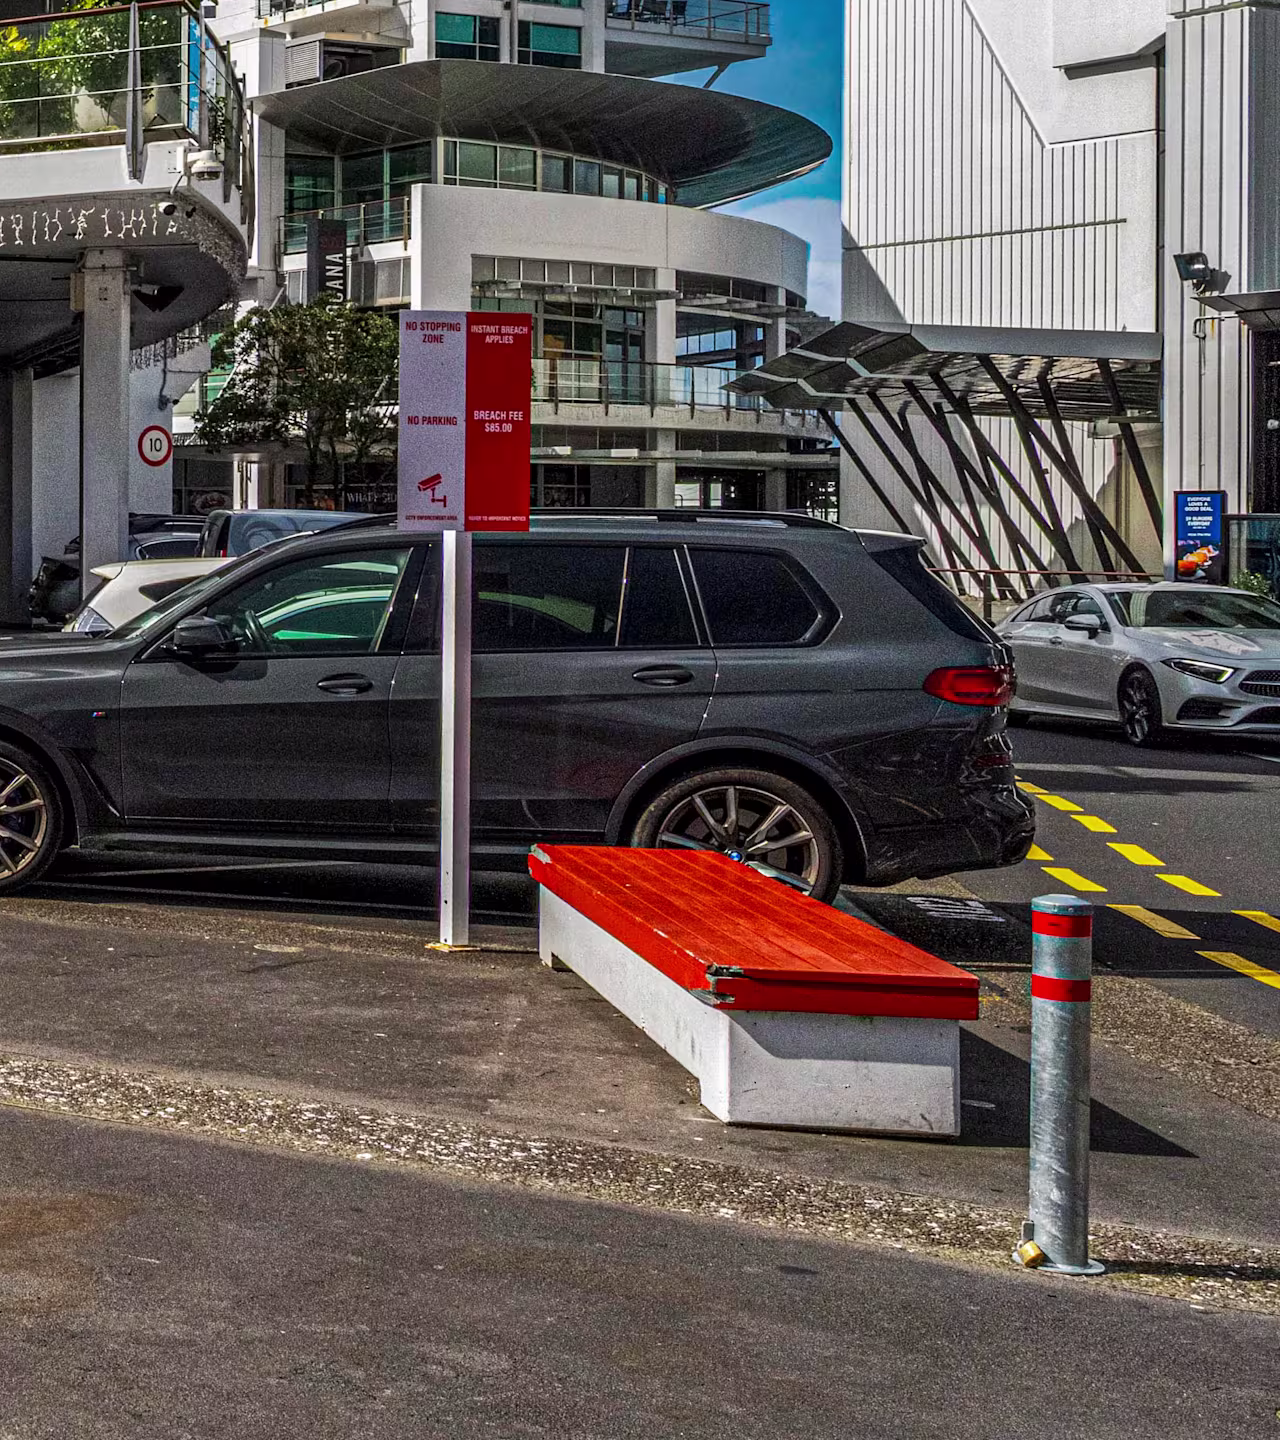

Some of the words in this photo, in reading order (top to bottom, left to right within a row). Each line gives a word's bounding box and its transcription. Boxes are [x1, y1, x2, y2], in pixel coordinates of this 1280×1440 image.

[405, 321, 417, 331] NO
[420, 321, 461, 332] STOPPING
[471, 325, 499, 334] INSTANT
[501, 325, 528, 335] BREACH
[422, 333, 444, 344] ZONE
[485, 335, 514, 344] APPLIES
[407, 415, 419, 425] NO
[421, 415, 457, 426] PARKING
[473, 410, 507, 420] BREACH
[508, 411, 524, 421] FEE
[484, 422, 513, 433] $85.00
[149, 438, 162, 452] 10
